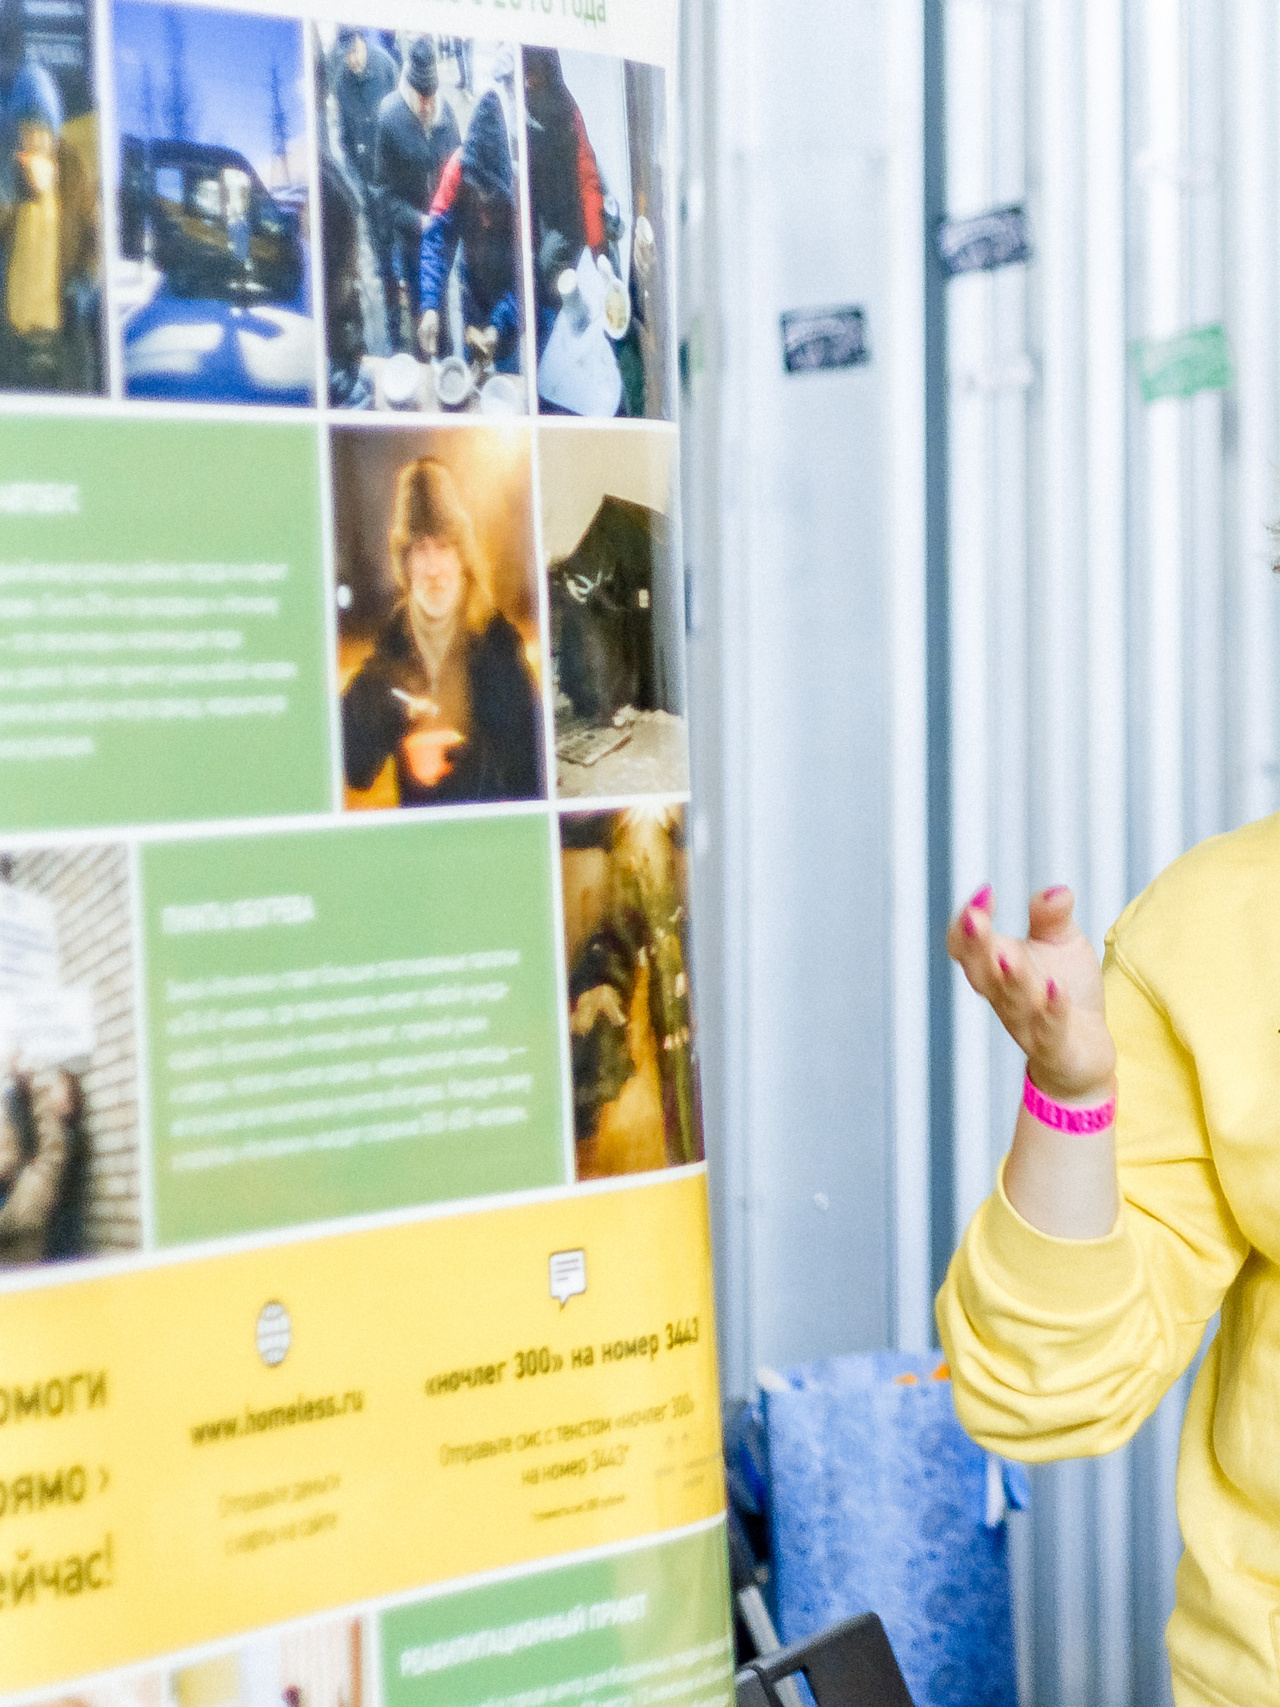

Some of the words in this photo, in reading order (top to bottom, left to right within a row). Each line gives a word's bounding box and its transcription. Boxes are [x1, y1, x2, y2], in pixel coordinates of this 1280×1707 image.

[425, 1360, 507, 1397] «ночлег
[514, 1345, 565, 1380] 300»
[571, 1346, 595, 1369] на
[601, 1333, 660, 1364] номер
[665, 1316, 700, 1350] 3443
[189, 1390, 363, 1446] www.homeless.ru
